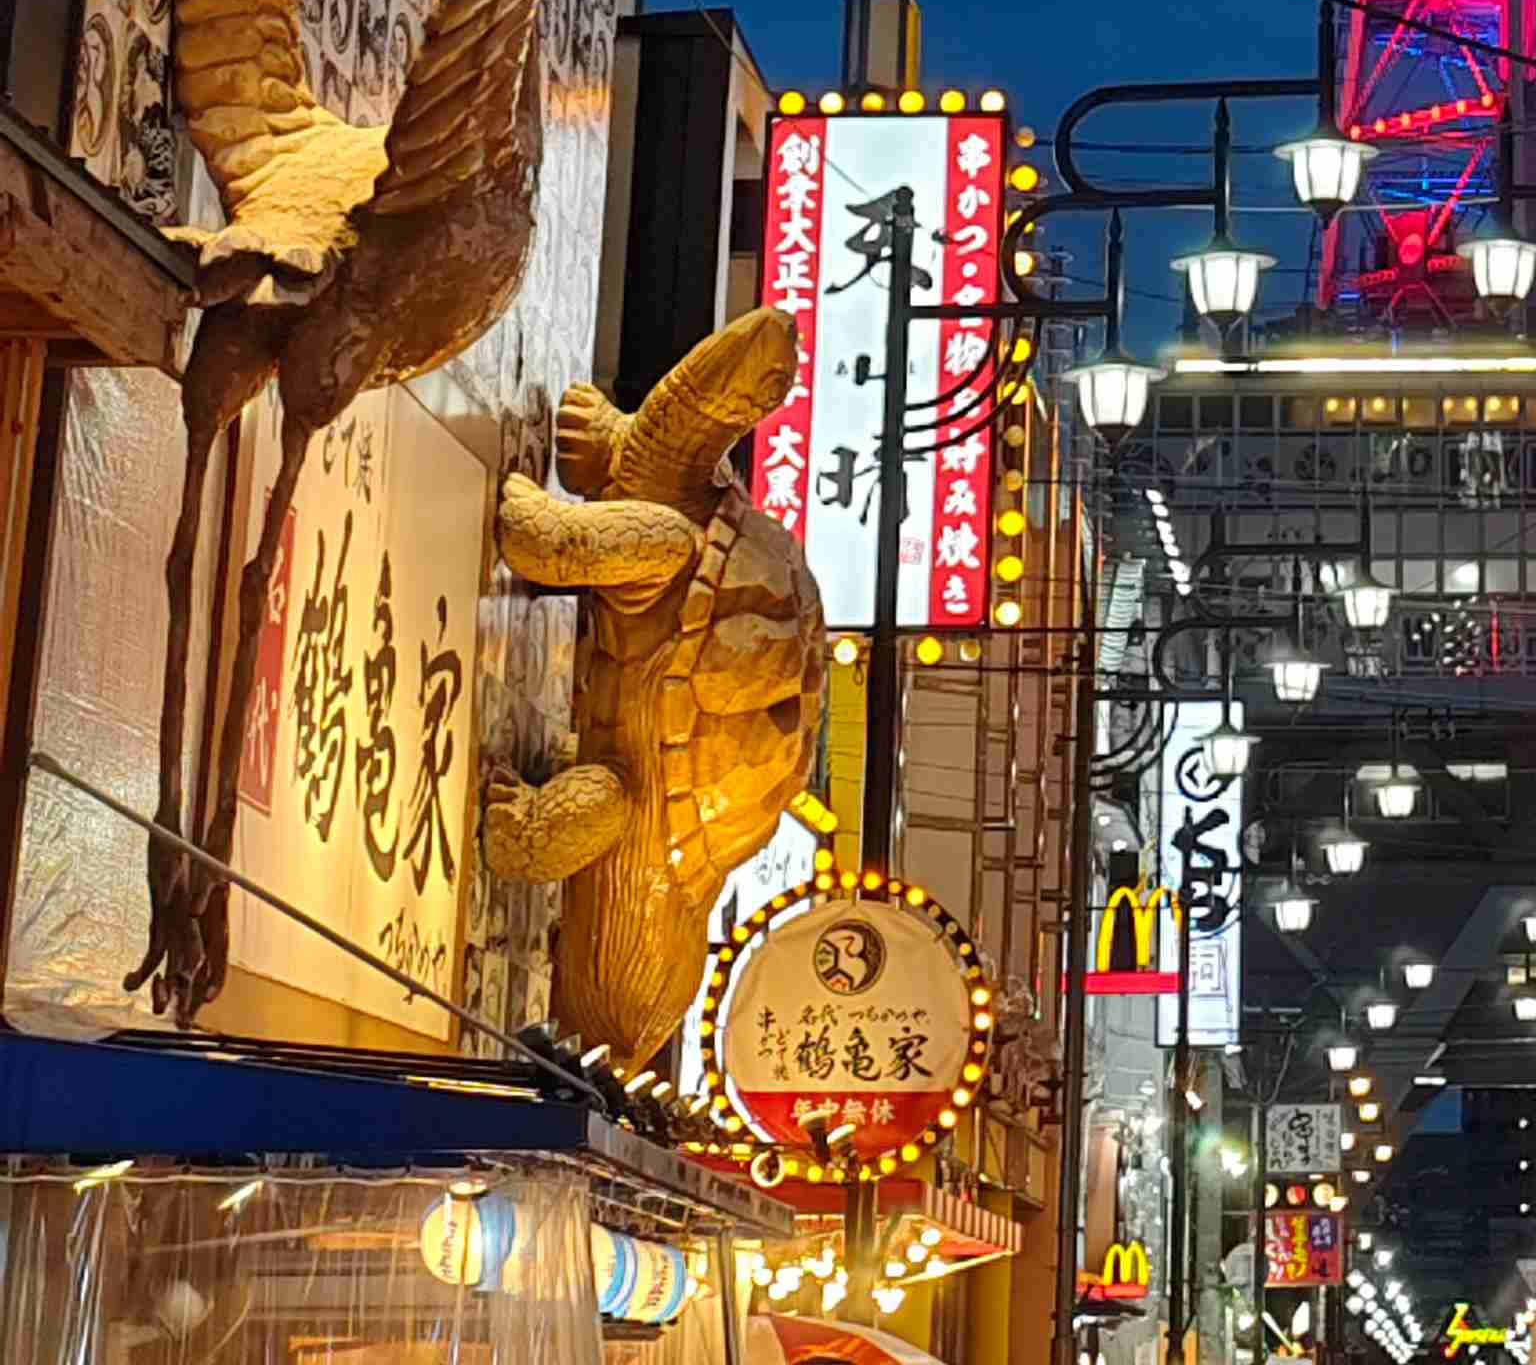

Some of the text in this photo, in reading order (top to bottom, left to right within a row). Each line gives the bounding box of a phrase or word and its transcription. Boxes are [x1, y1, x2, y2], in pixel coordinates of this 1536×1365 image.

[292, 507, 464, 898] 鶴亀家
[793, 1024, 935, 1082] 鶴亀家
